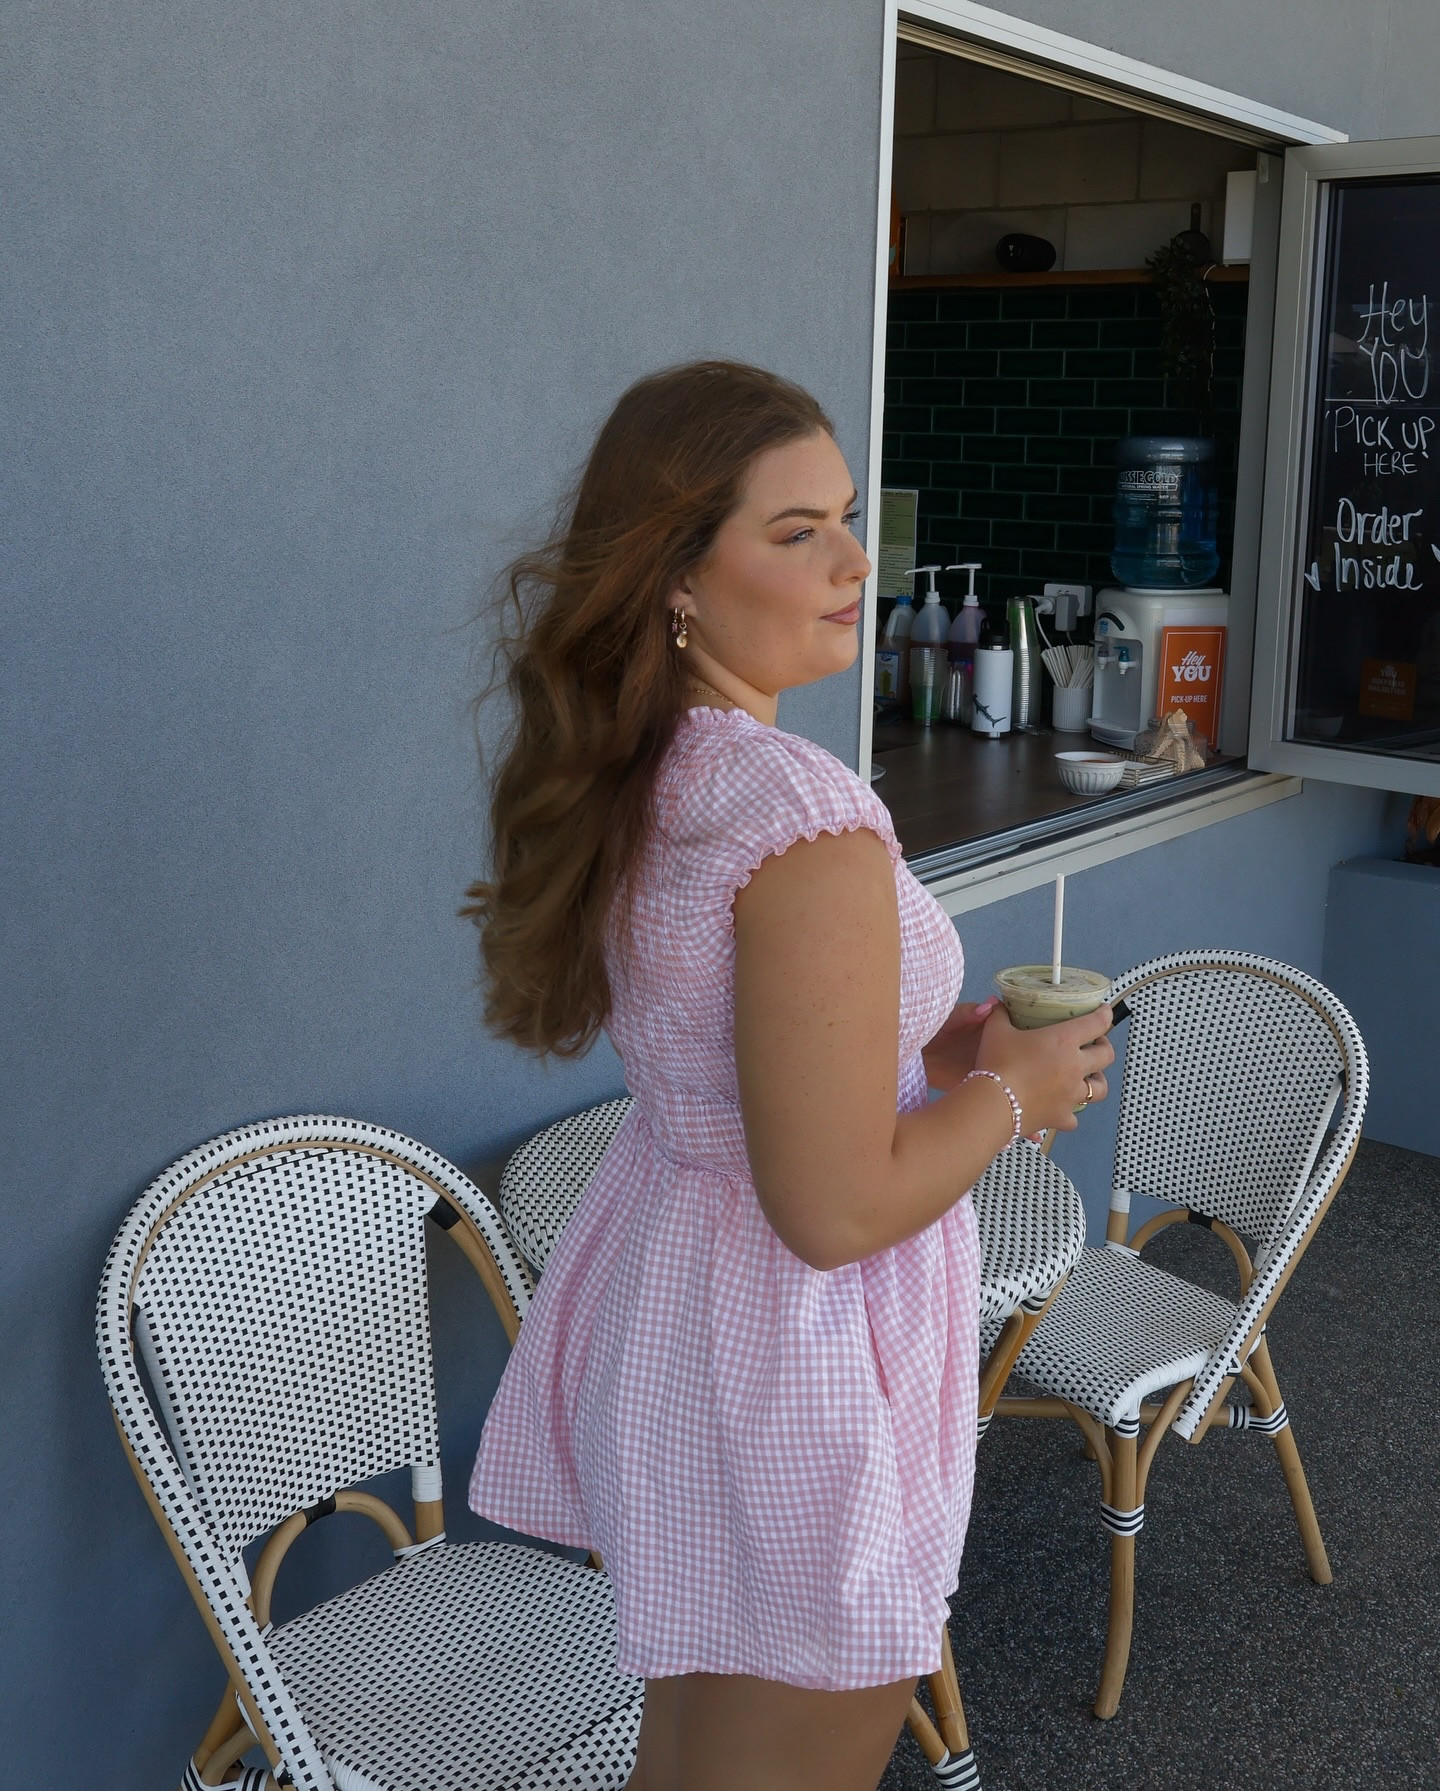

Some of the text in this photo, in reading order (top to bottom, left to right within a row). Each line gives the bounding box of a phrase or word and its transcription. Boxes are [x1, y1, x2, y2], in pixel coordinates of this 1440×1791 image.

[1356, 281, 1428, 359] Hey
[1359, 337, 1429, 405] YOU
[1334, 406, 1435, 452] PICK UP
[1364, 451, 1418, 477] HERE
[1336, 497, 1423, 546] Order
[1334, 542, 1423, 592] Inside
[1171, 665, 1212, 682] YOU
[1181, 650, 1206, 670] Hey
[1170, 694, 1208, 704] PICK-UP HERE
